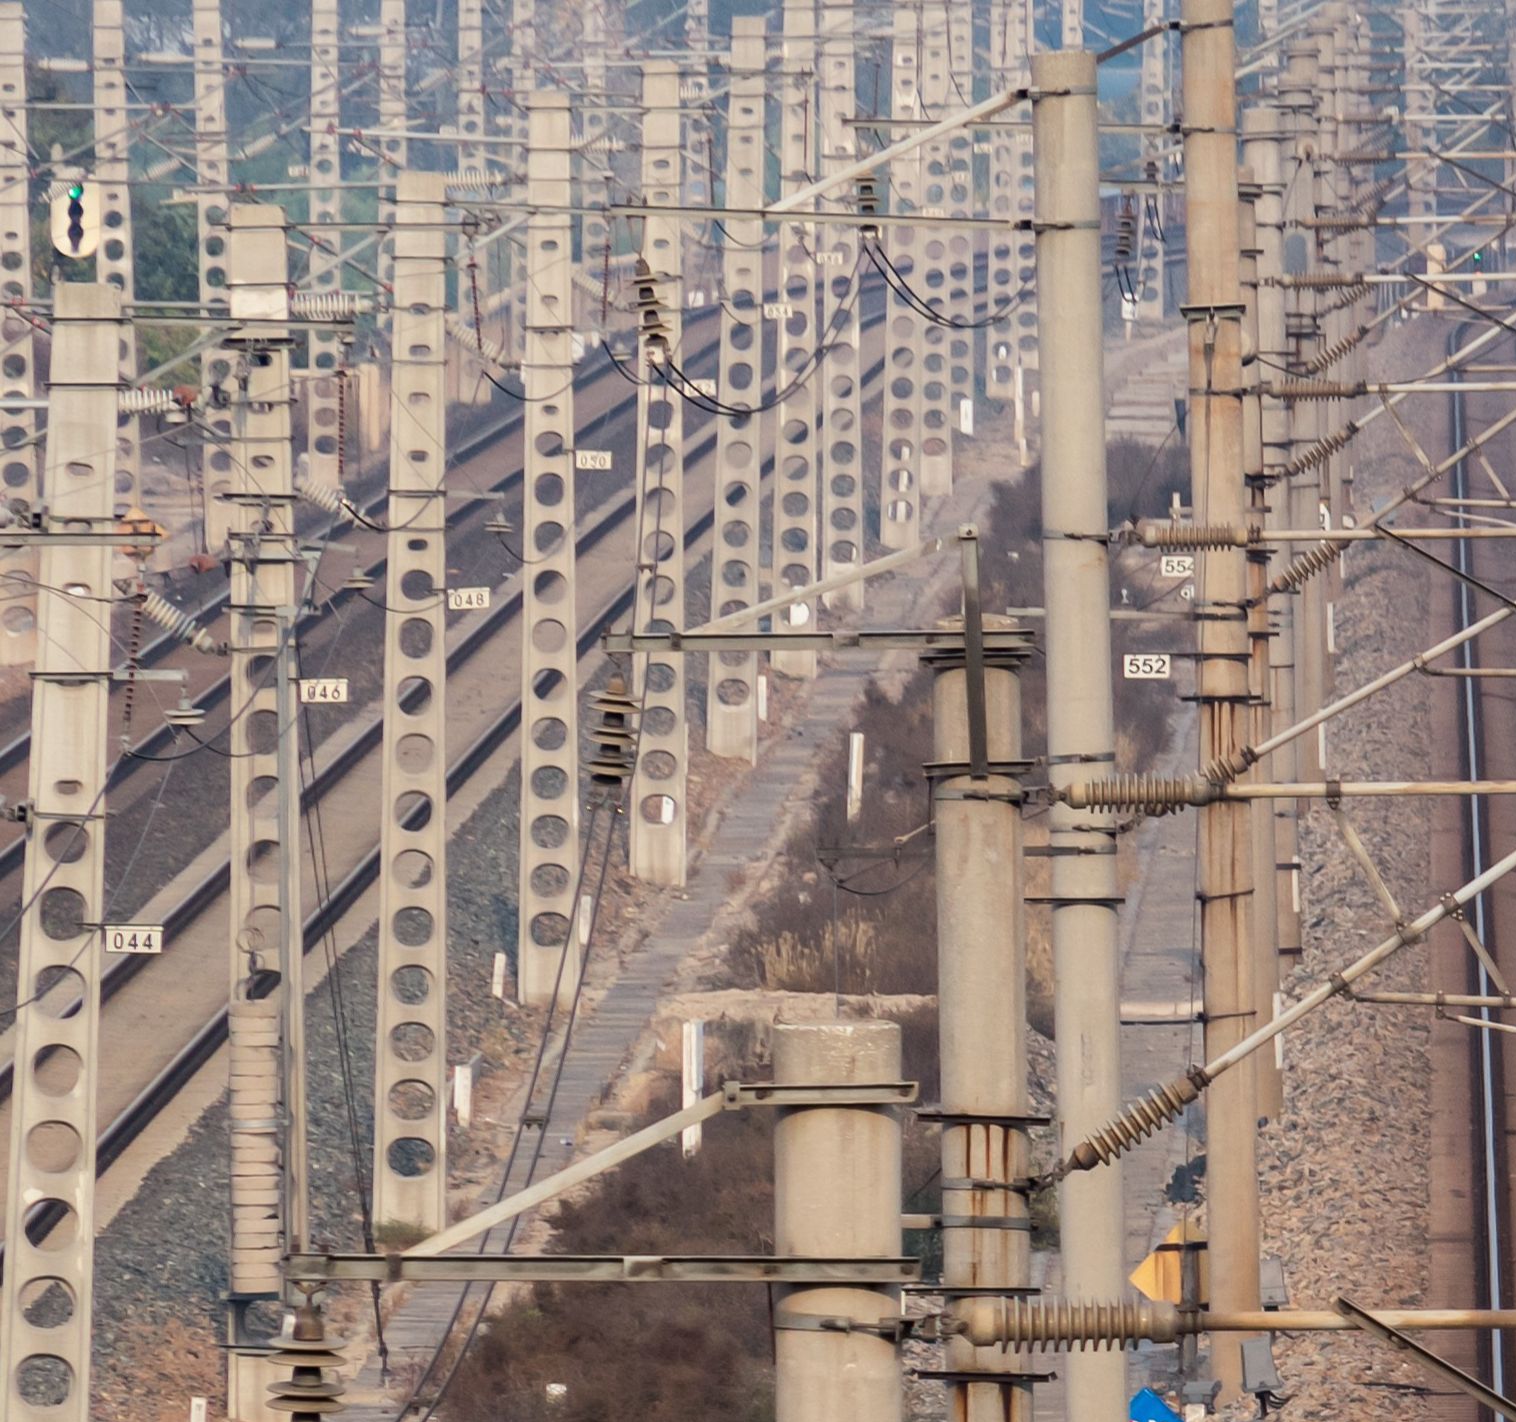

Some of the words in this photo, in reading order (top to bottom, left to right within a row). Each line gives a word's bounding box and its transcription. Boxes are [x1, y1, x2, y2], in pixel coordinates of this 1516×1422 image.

[454, 592, 484, 608] 048
[1128, 658, 1167, 674] 552
[307, 684, 341, 701] 046
[113, 932, 153, 950] 044
